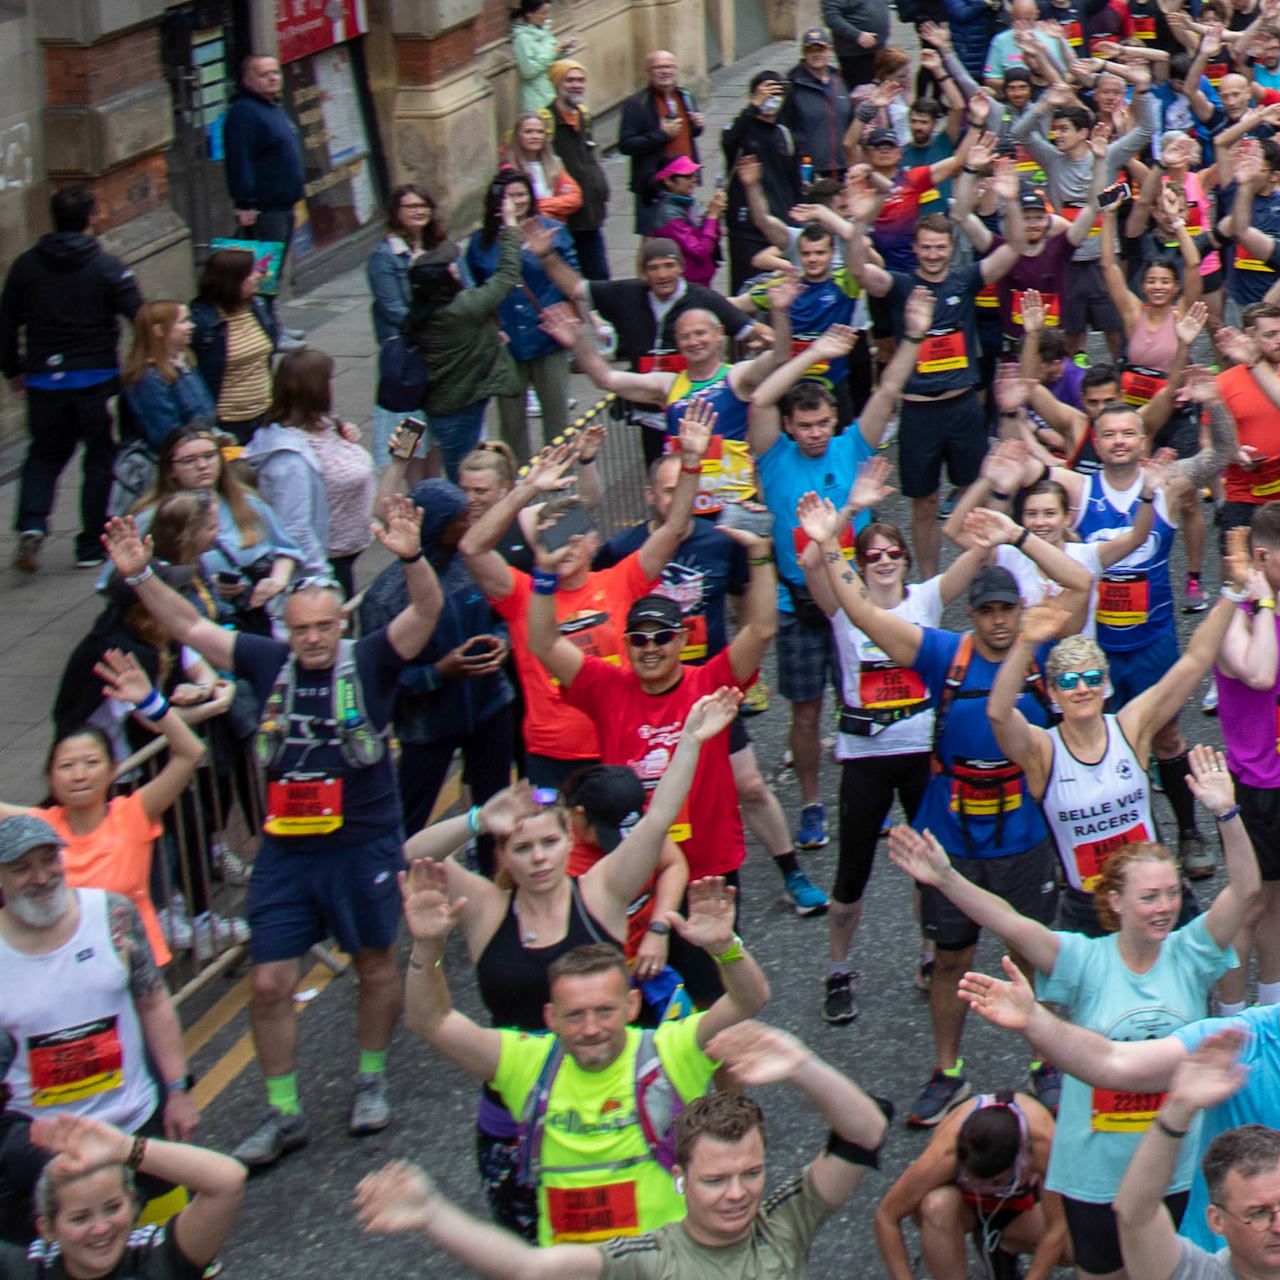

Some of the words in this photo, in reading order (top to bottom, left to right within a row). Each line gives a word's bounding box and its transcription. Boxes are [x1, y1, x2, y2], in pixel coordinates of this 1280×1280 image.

[881, 671, 903, 685] EVE
[1058, 802, 1112, 823] BELLE
[1116, 789, 1145, 809] VUE
[1074, 809, 1139, 837] RACERS
